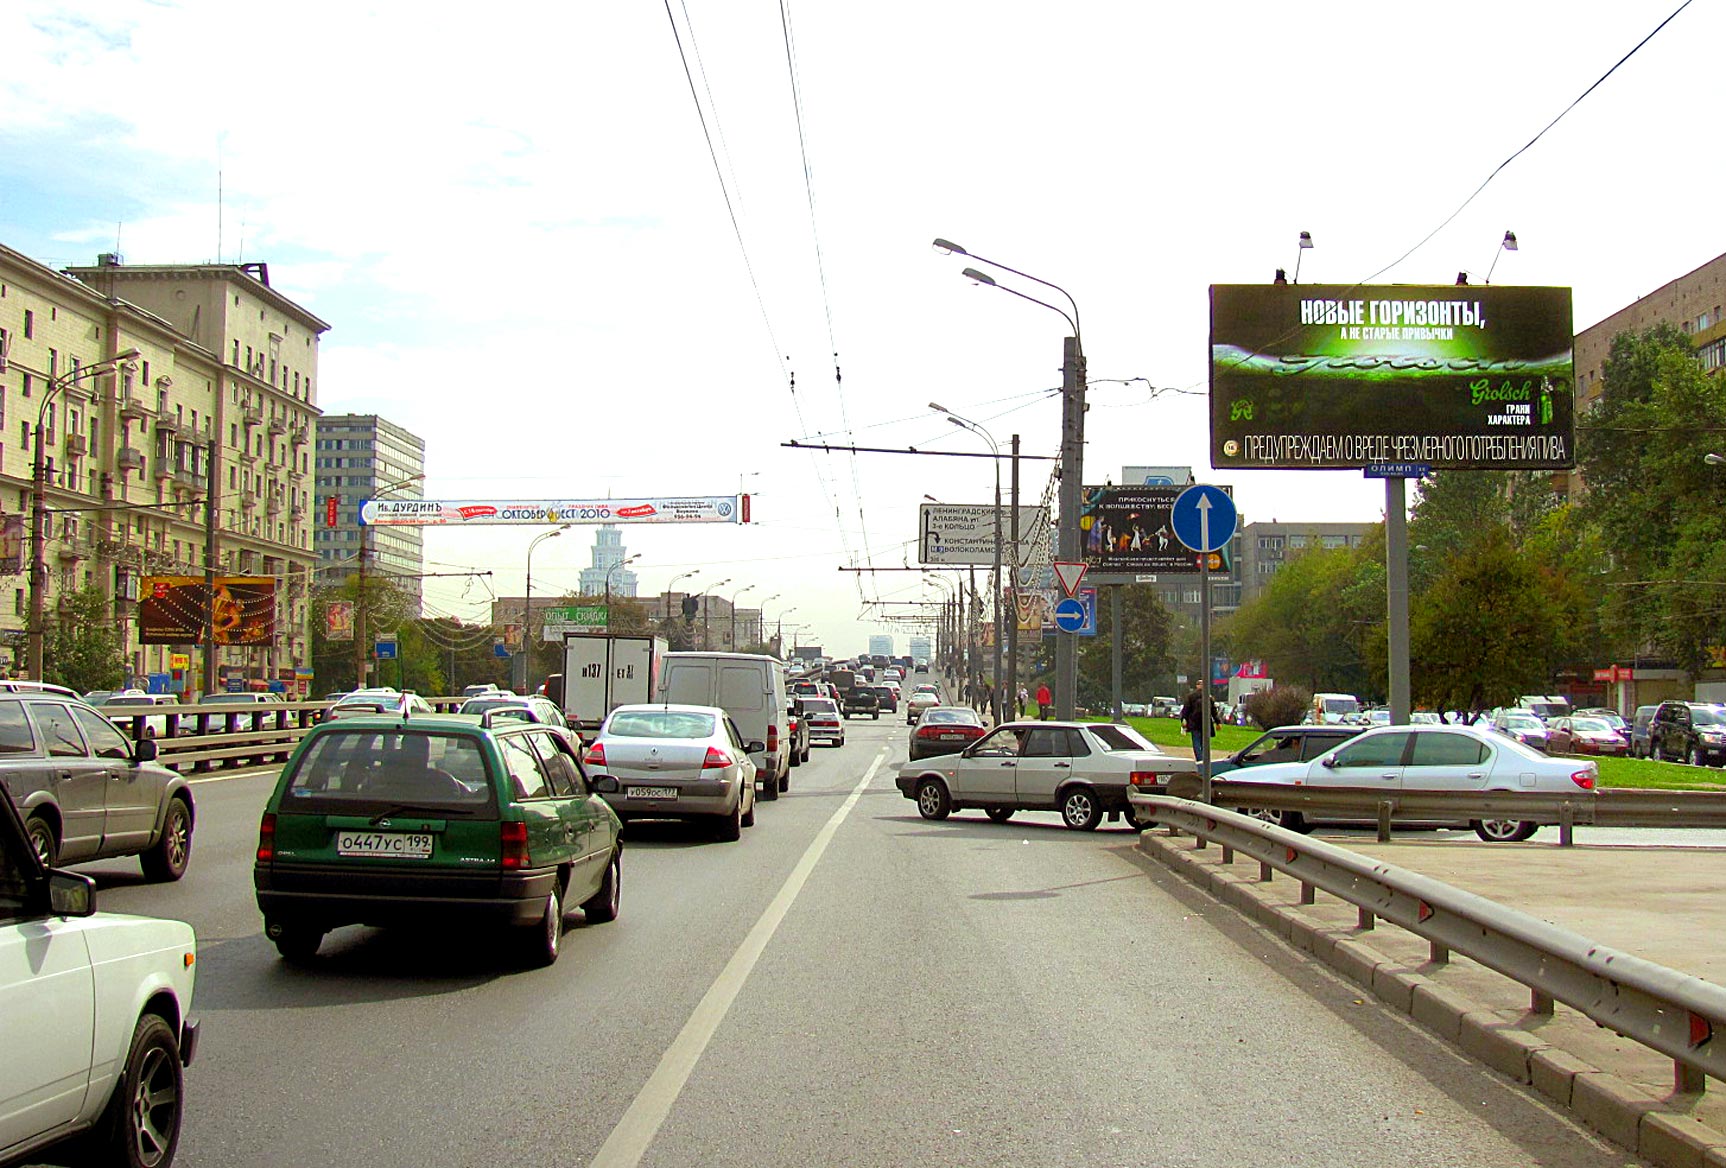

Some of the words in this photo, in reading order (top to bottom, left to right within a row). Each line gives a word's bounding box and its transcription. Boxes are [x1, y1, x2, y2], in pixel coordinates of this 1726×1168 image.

[1300, 300, 1365, 325] НОВЫЕ
[1369, 300, 1486, 329] ГОРИЗОНТЫ,
[1340, 327, 1347, 340] А
[1349, 327, 1361, 340] НЕ
[1362, 327, 1400, 340] СТАРЫЕ
[1402, 327, 1453, 340] ПРИВЫЧКИ
[1469, 378, 1532, 405] Grolsch
[1505, 404, 1531, 415] ГРАНИ
[1487, 414, 1531, 426] ХАРАКТЕРА
[1244, 434, 1343, 465] ПРЕДУПРЕЖДАЕМ
[1345, 435, 1353, 461] О
[1355, 434, 1390, 465] ВРЕДЕ
[1390, 435, 1464, 461] ЧРЕЗМЕРНОГО
[1465, 435, 1536, 461] ПОТРЕБЛЕНИЯ
[1537, 435, 1566, 461] ПИВА
[392, 502, 442, 513] ДУРДИНЪ
[580, 508, 610, 519] 2010
[944, 523, 975, 531] КОЛЬЦО
[342, 834, 403, 851] О447УС
[406, 836, 430, 848] 199
